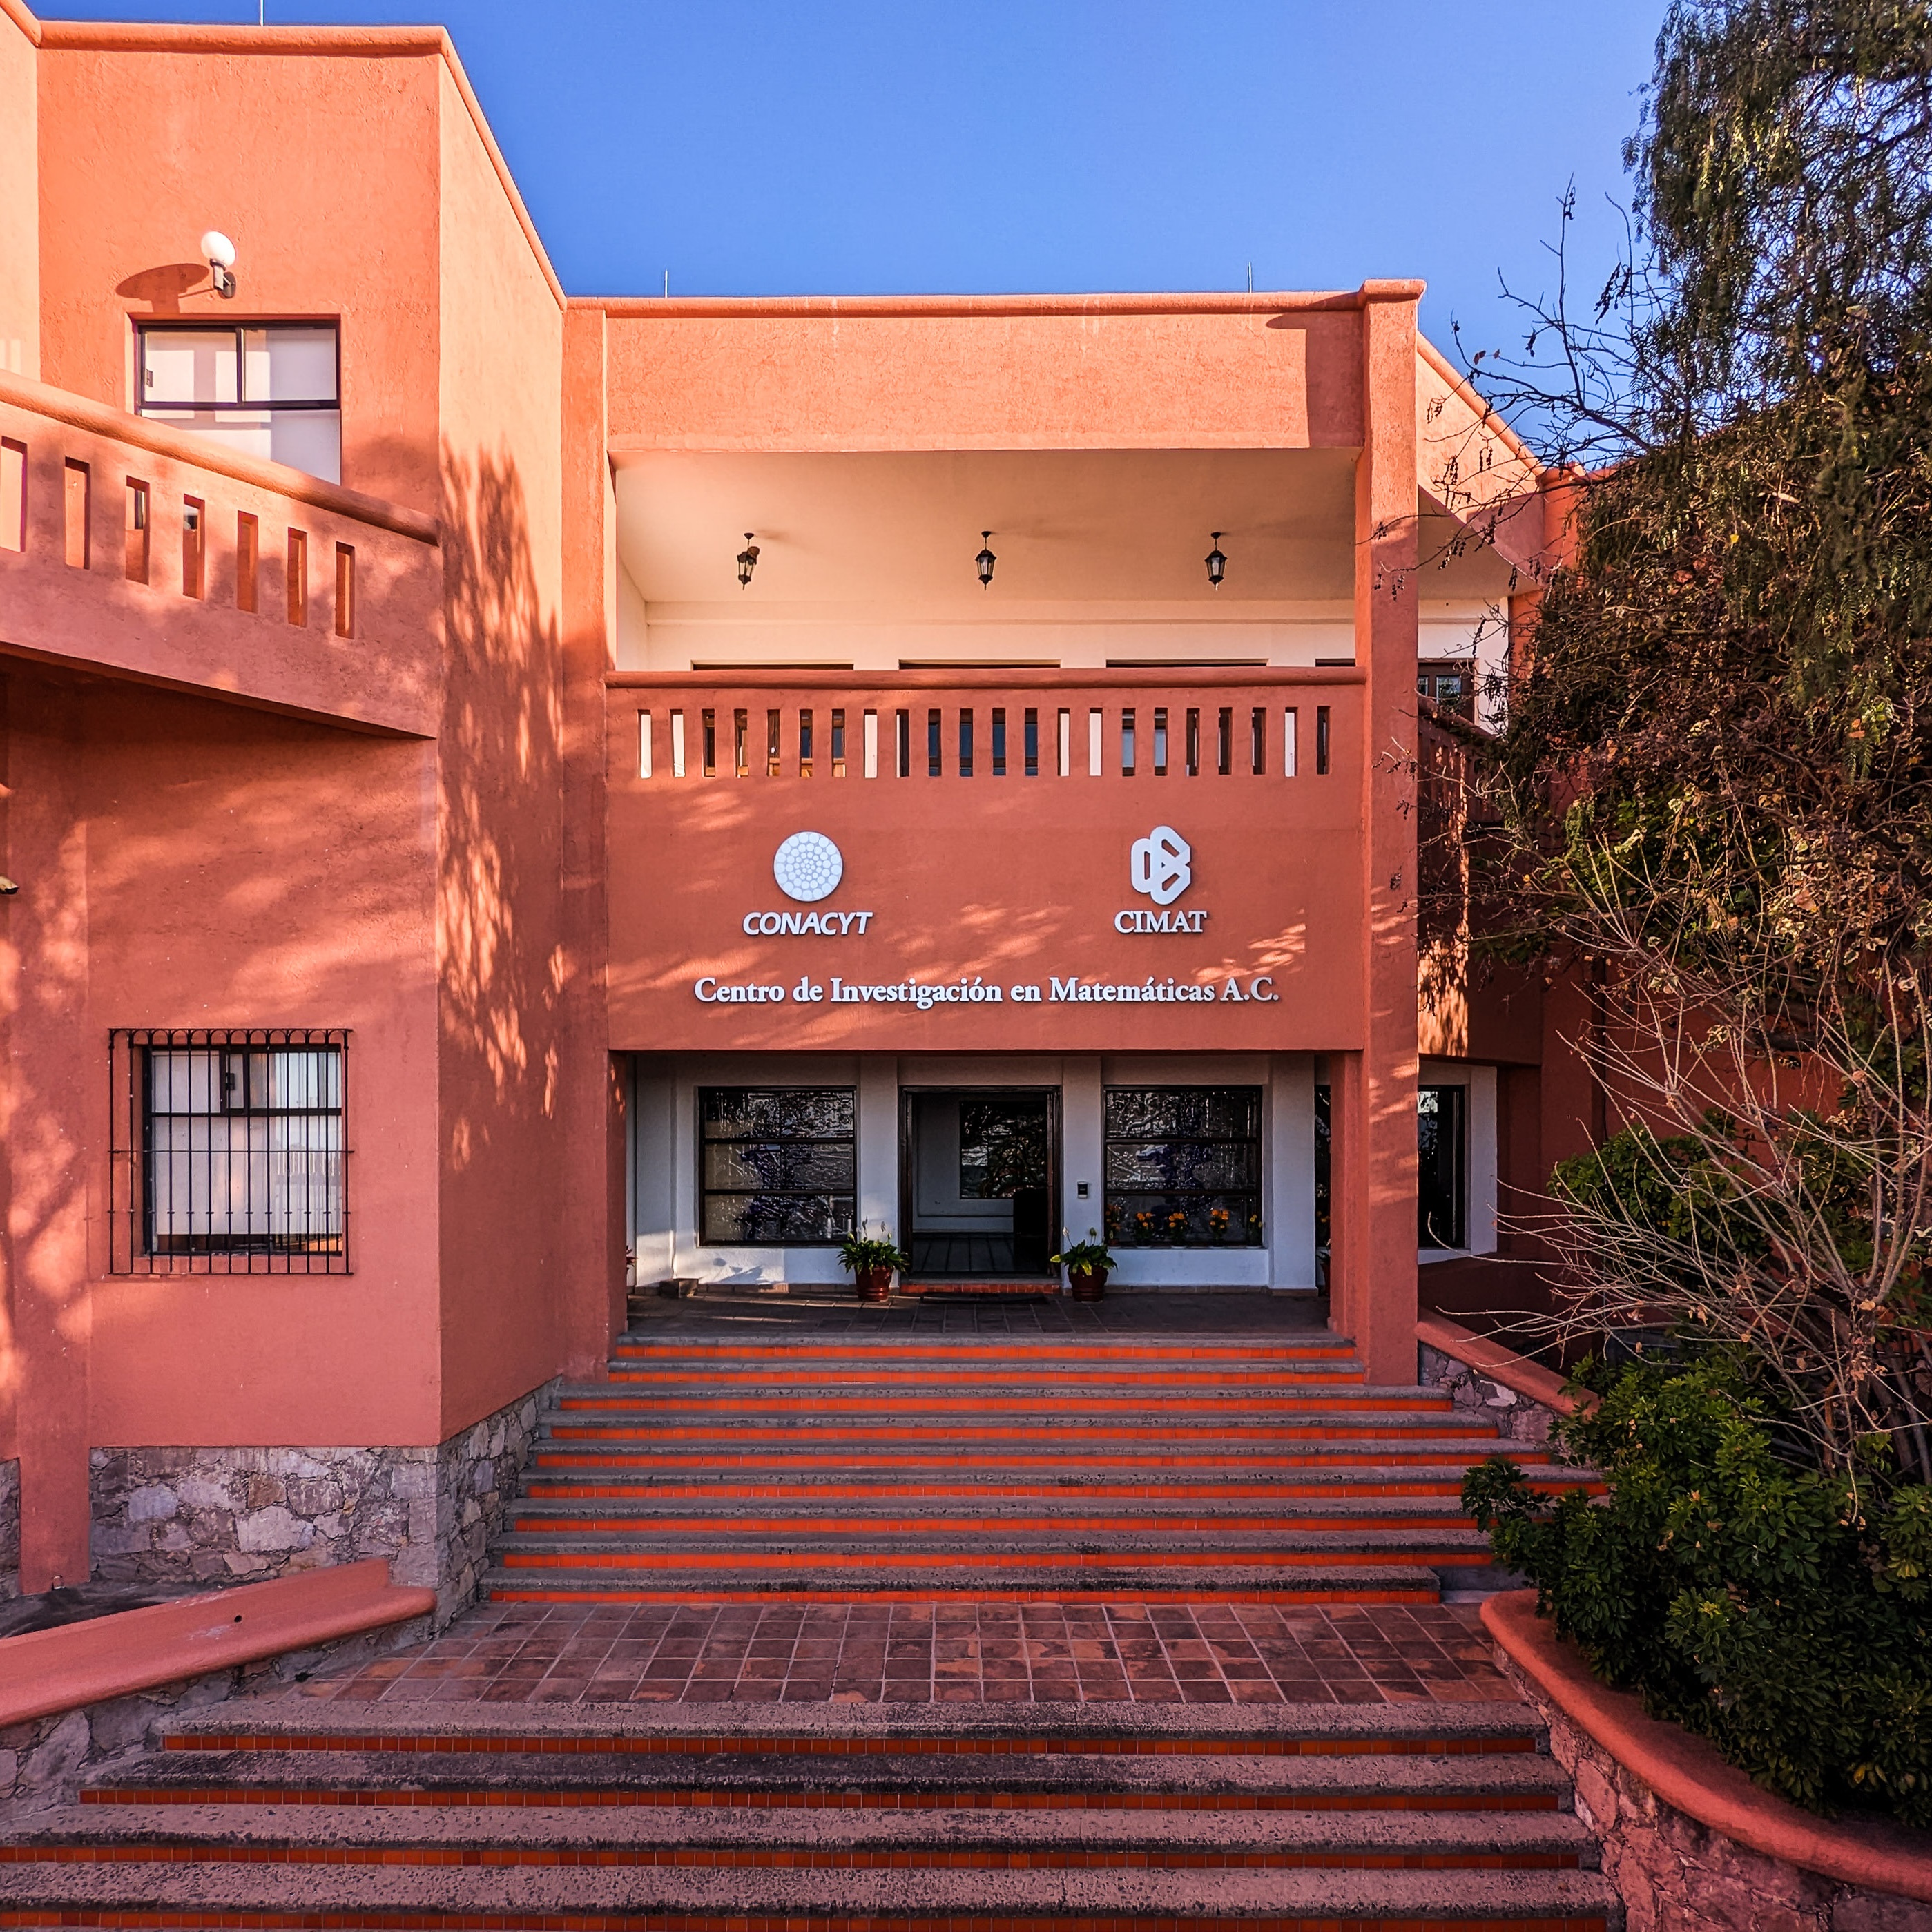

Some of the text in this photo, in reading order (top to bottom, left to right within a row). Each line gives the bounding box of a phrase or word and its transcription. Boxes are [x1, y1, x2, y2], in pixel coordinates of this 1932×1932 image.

[743, 911, 873, 935] CONACYT
[1114, 910, 1207, 934] CIMAT
[694, 975, 1279, 1010] Centro de Investigación en Matemáticas A.C.
